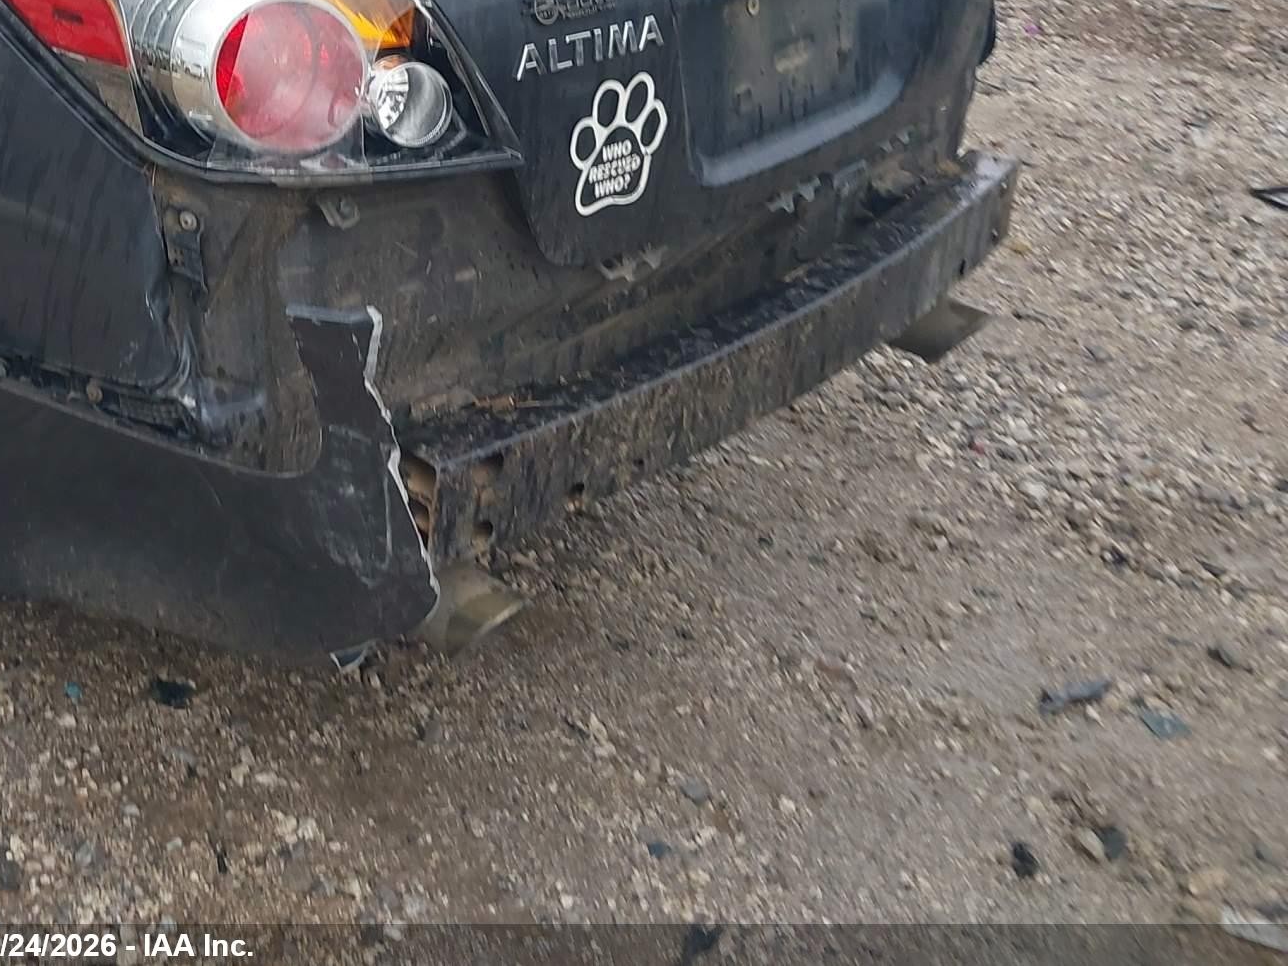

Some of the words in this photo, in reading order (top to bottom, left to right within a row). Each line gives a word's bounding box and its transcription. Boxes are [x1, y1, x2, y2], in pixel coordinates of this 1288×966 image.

[515, 13, 664, 81] ALTIMA
[602, 139, 633, 163] WHO
[588, 153, 641, 184] RESCUED
[594, 173, 631, 199] WHO?
